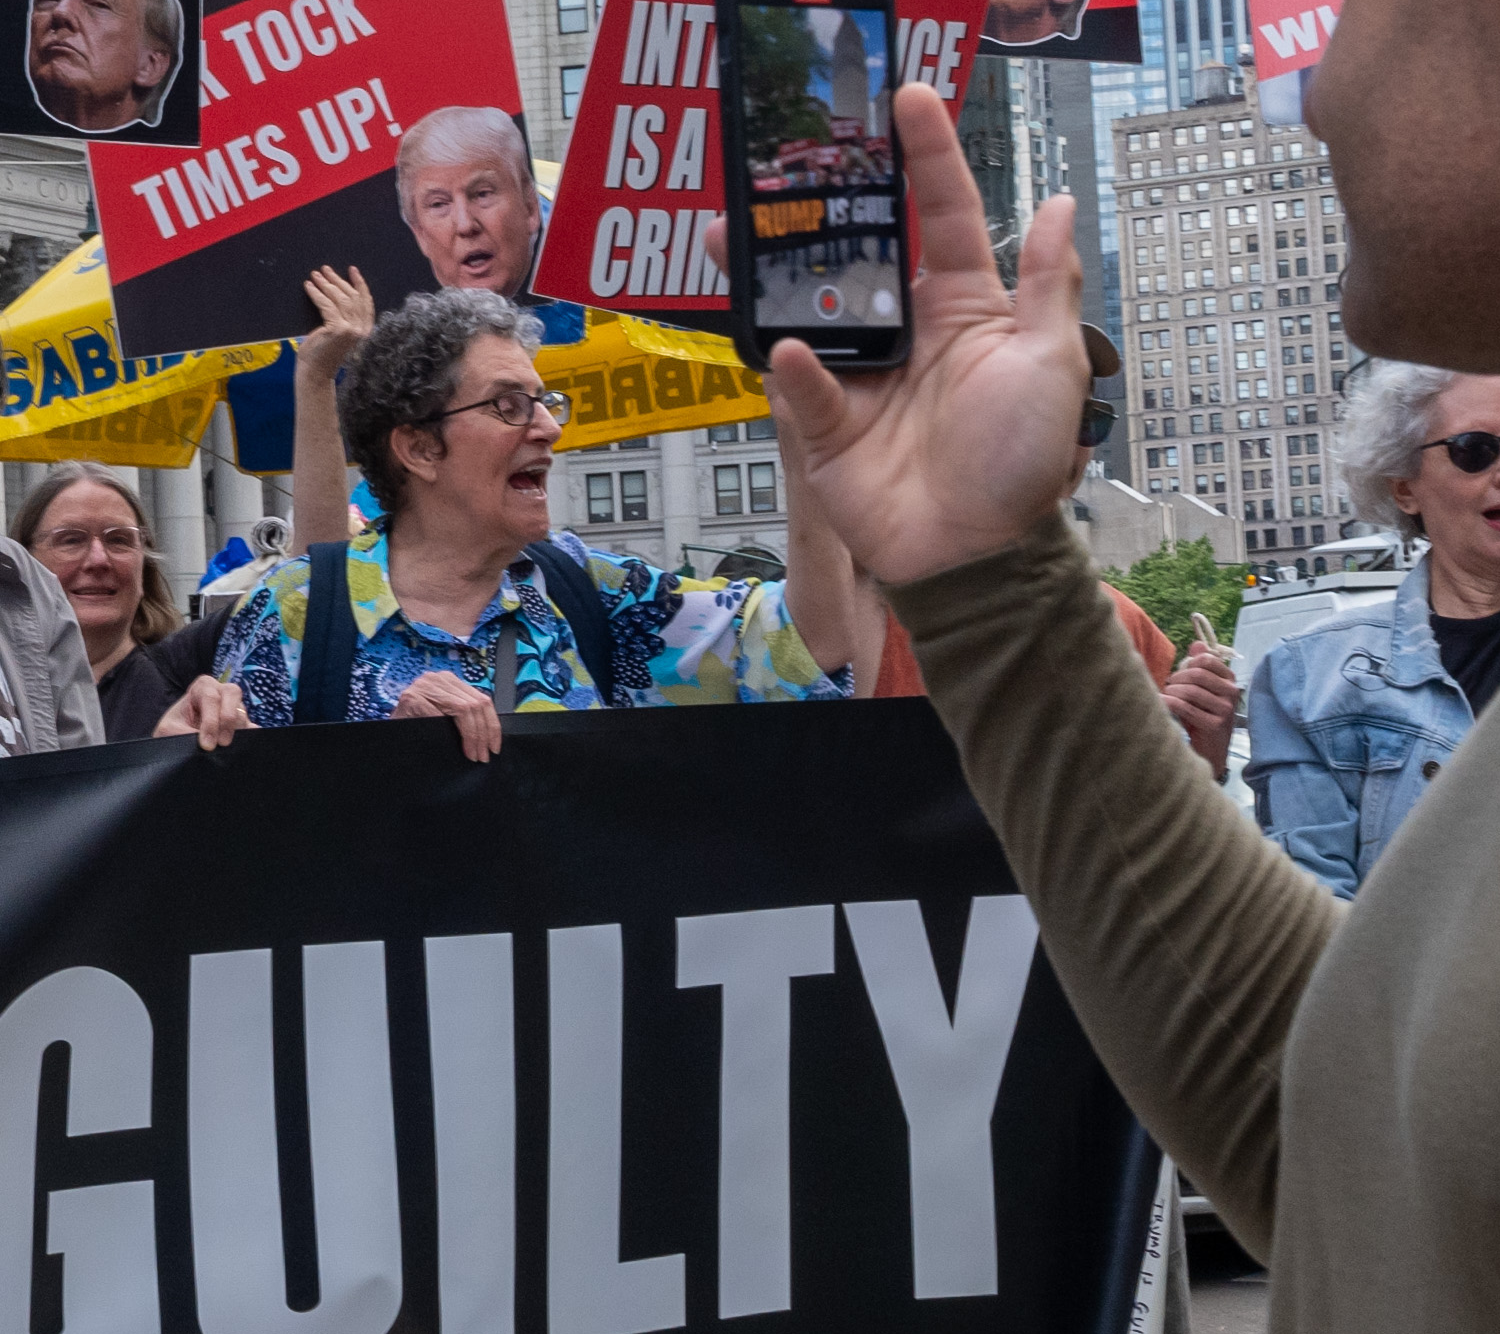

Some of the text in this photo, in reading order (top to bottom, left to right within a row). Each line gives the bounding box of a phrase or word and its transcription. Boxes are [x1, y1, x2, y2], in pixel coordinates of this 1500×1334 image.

[35, 176, 88, 206] COU
[131, 76, 404, 241] TIMES UP!
[603, 104, 708, 191] IS A
